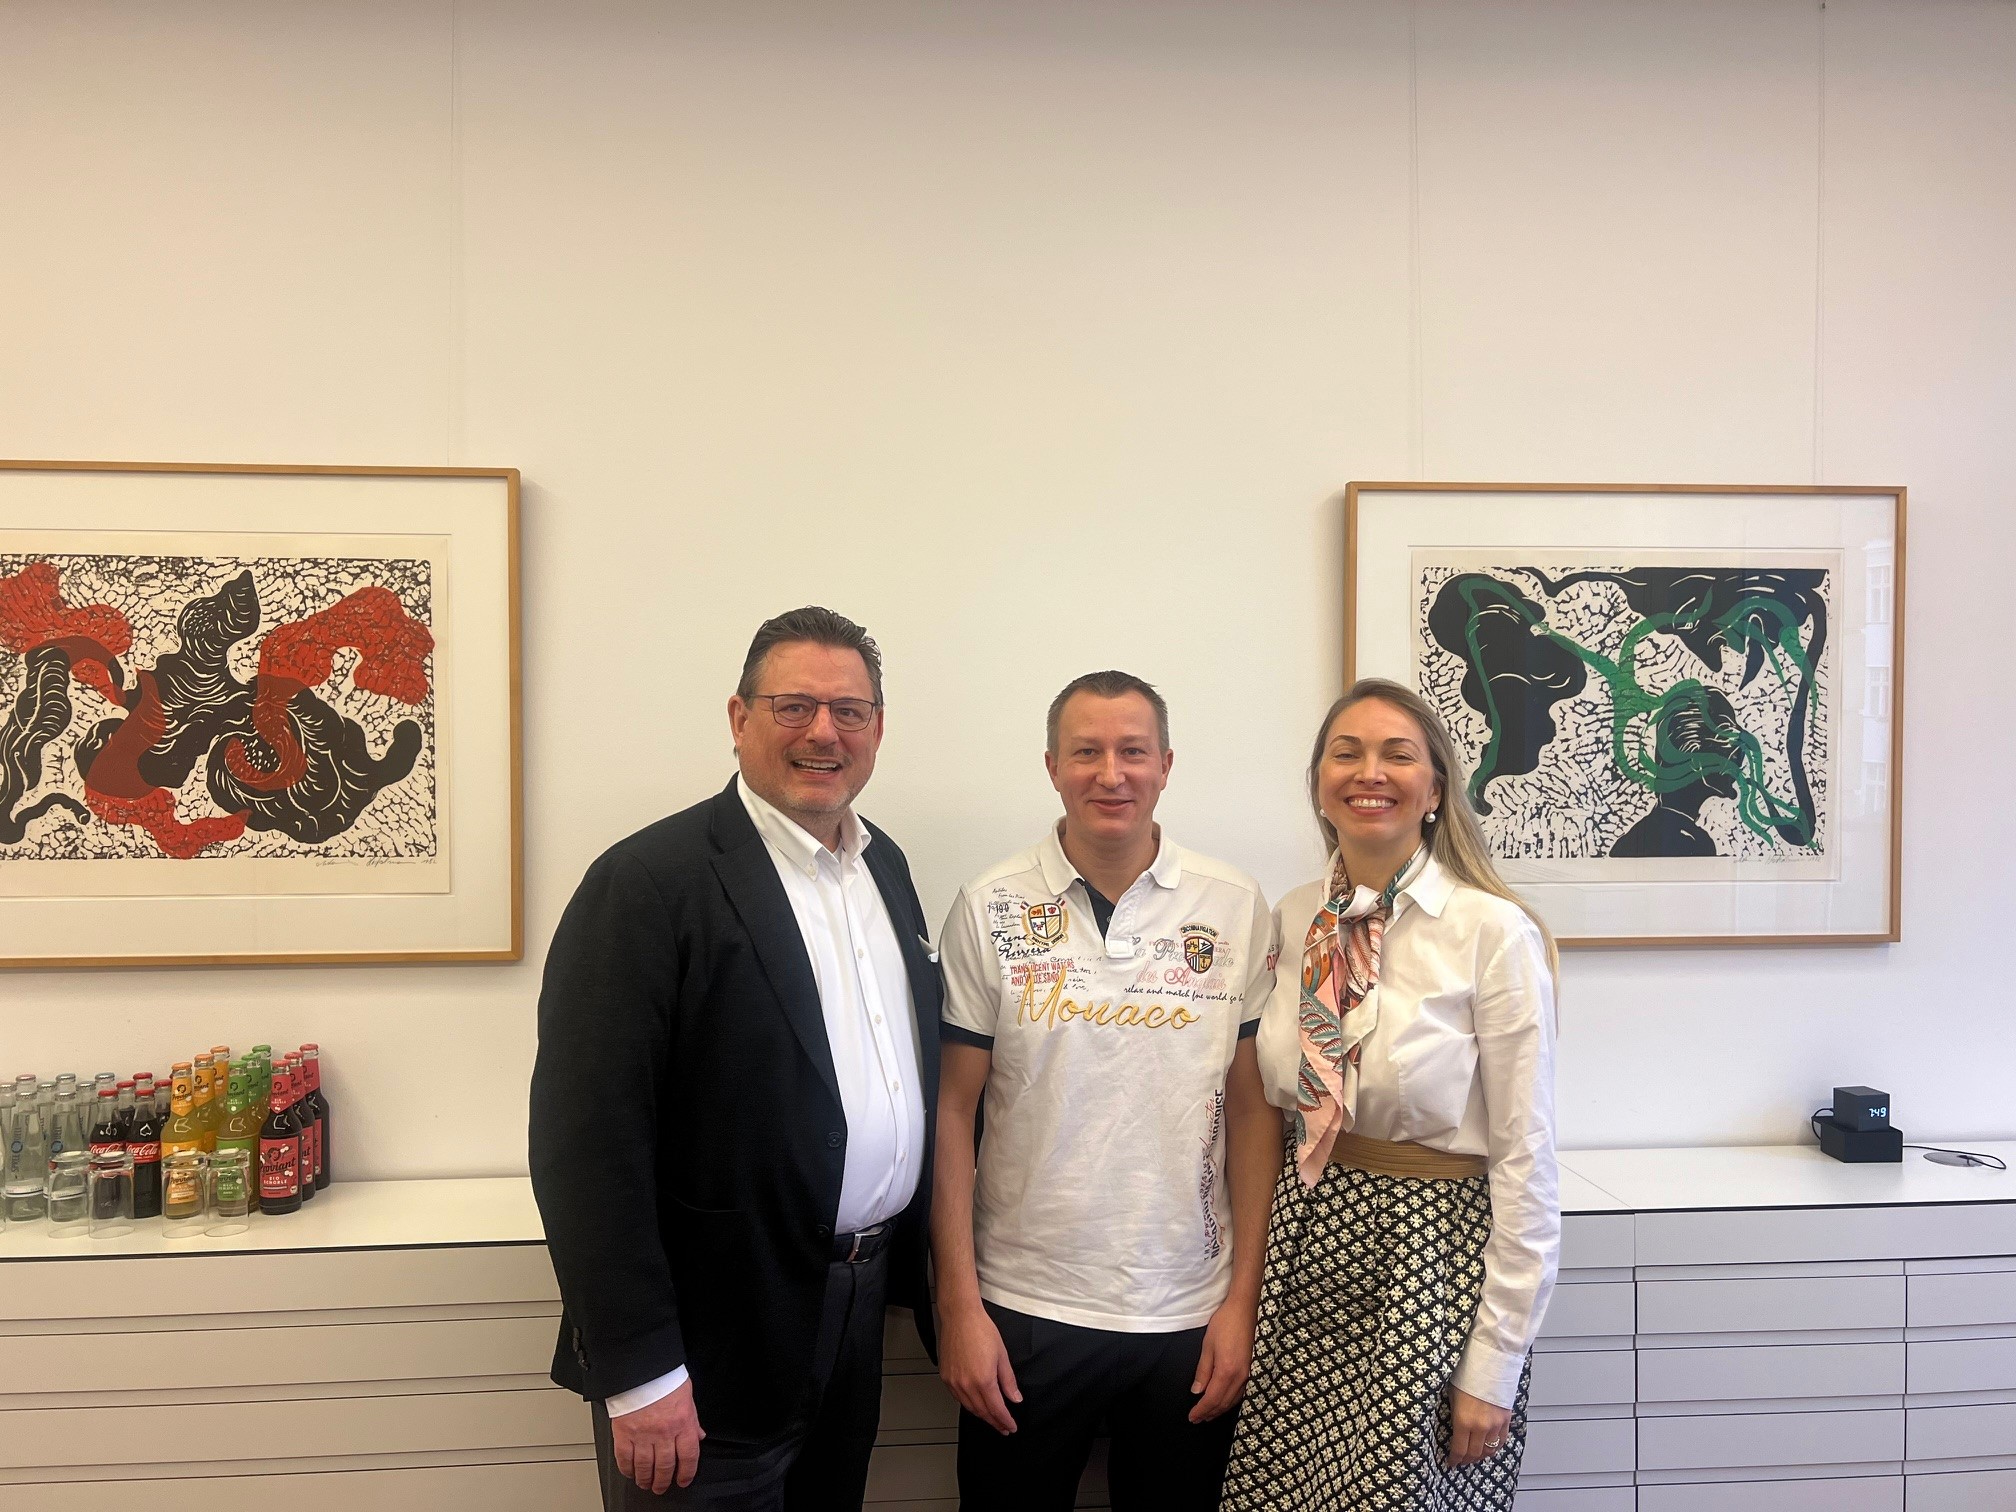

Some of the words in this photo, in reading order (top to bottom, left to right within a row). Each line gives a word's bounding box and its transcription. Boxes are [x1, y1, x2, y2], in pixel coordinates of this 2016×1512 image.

[991, 930, 1028, 945] Frenc
[1010, 963, 1050, 975] TRANSUCENT
[1018, 963, 1200, 1031] Monaco
[1146, 986, 1163, 995] and
